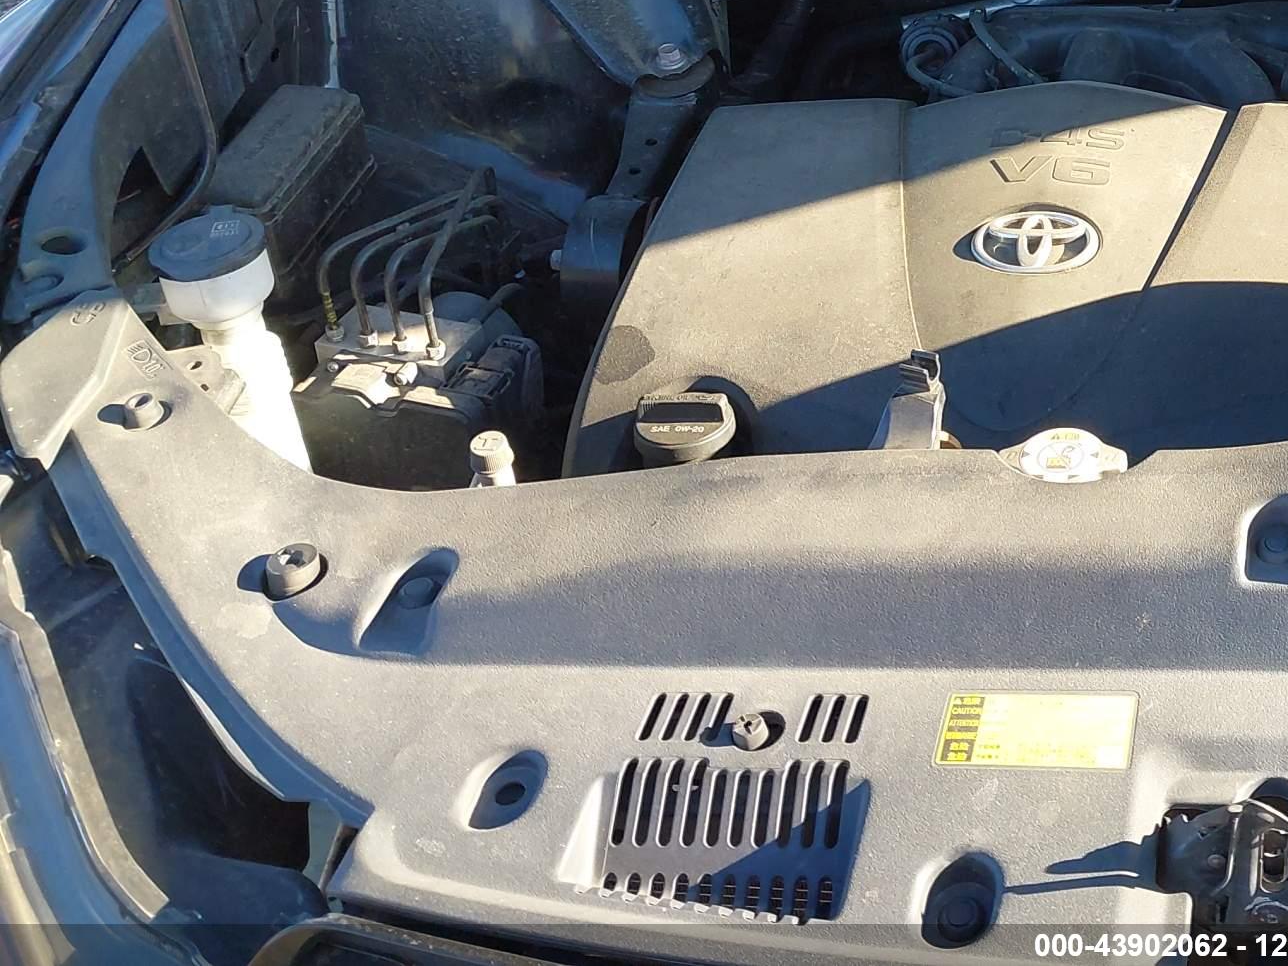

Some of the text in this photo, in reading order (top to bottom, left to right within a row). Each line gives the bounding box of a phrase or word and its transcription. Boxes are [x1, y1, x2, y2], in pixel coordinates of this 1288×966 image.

[989, 127, 1126, 151] D-4S
[989, 155, 1112, 186] V6
[649, 425, 705, 433] SAE 0W-20
